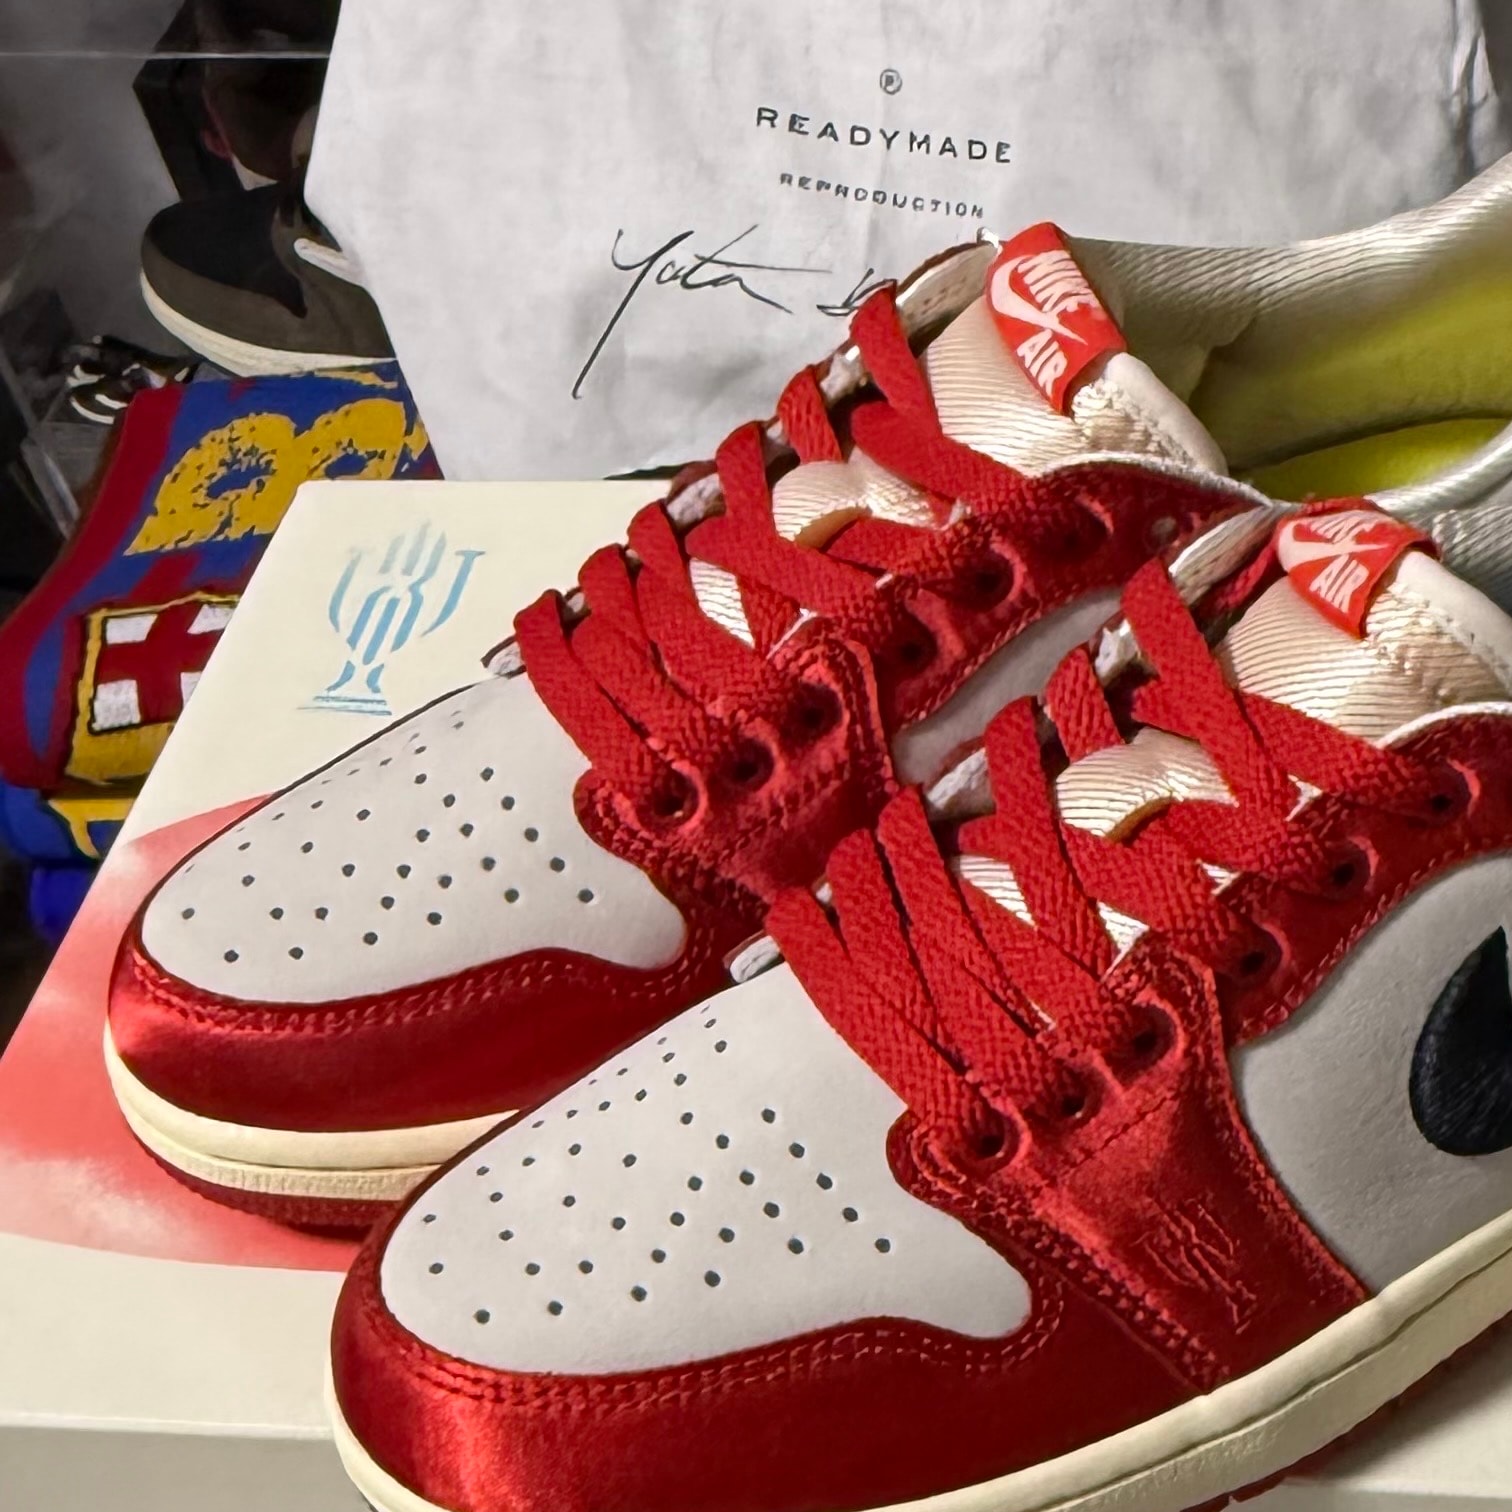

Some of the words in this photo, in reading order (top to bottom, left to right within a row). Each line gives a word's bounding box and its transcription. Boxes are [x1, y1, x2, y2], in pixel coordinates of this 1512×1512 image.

[756, 105, 1013, 164] READYMADE
[779, 171, 985, 220] REPRODUCTION
[1017, 329, 1068, 399] AIR
[1309, 554, 1369, 614] AIR
